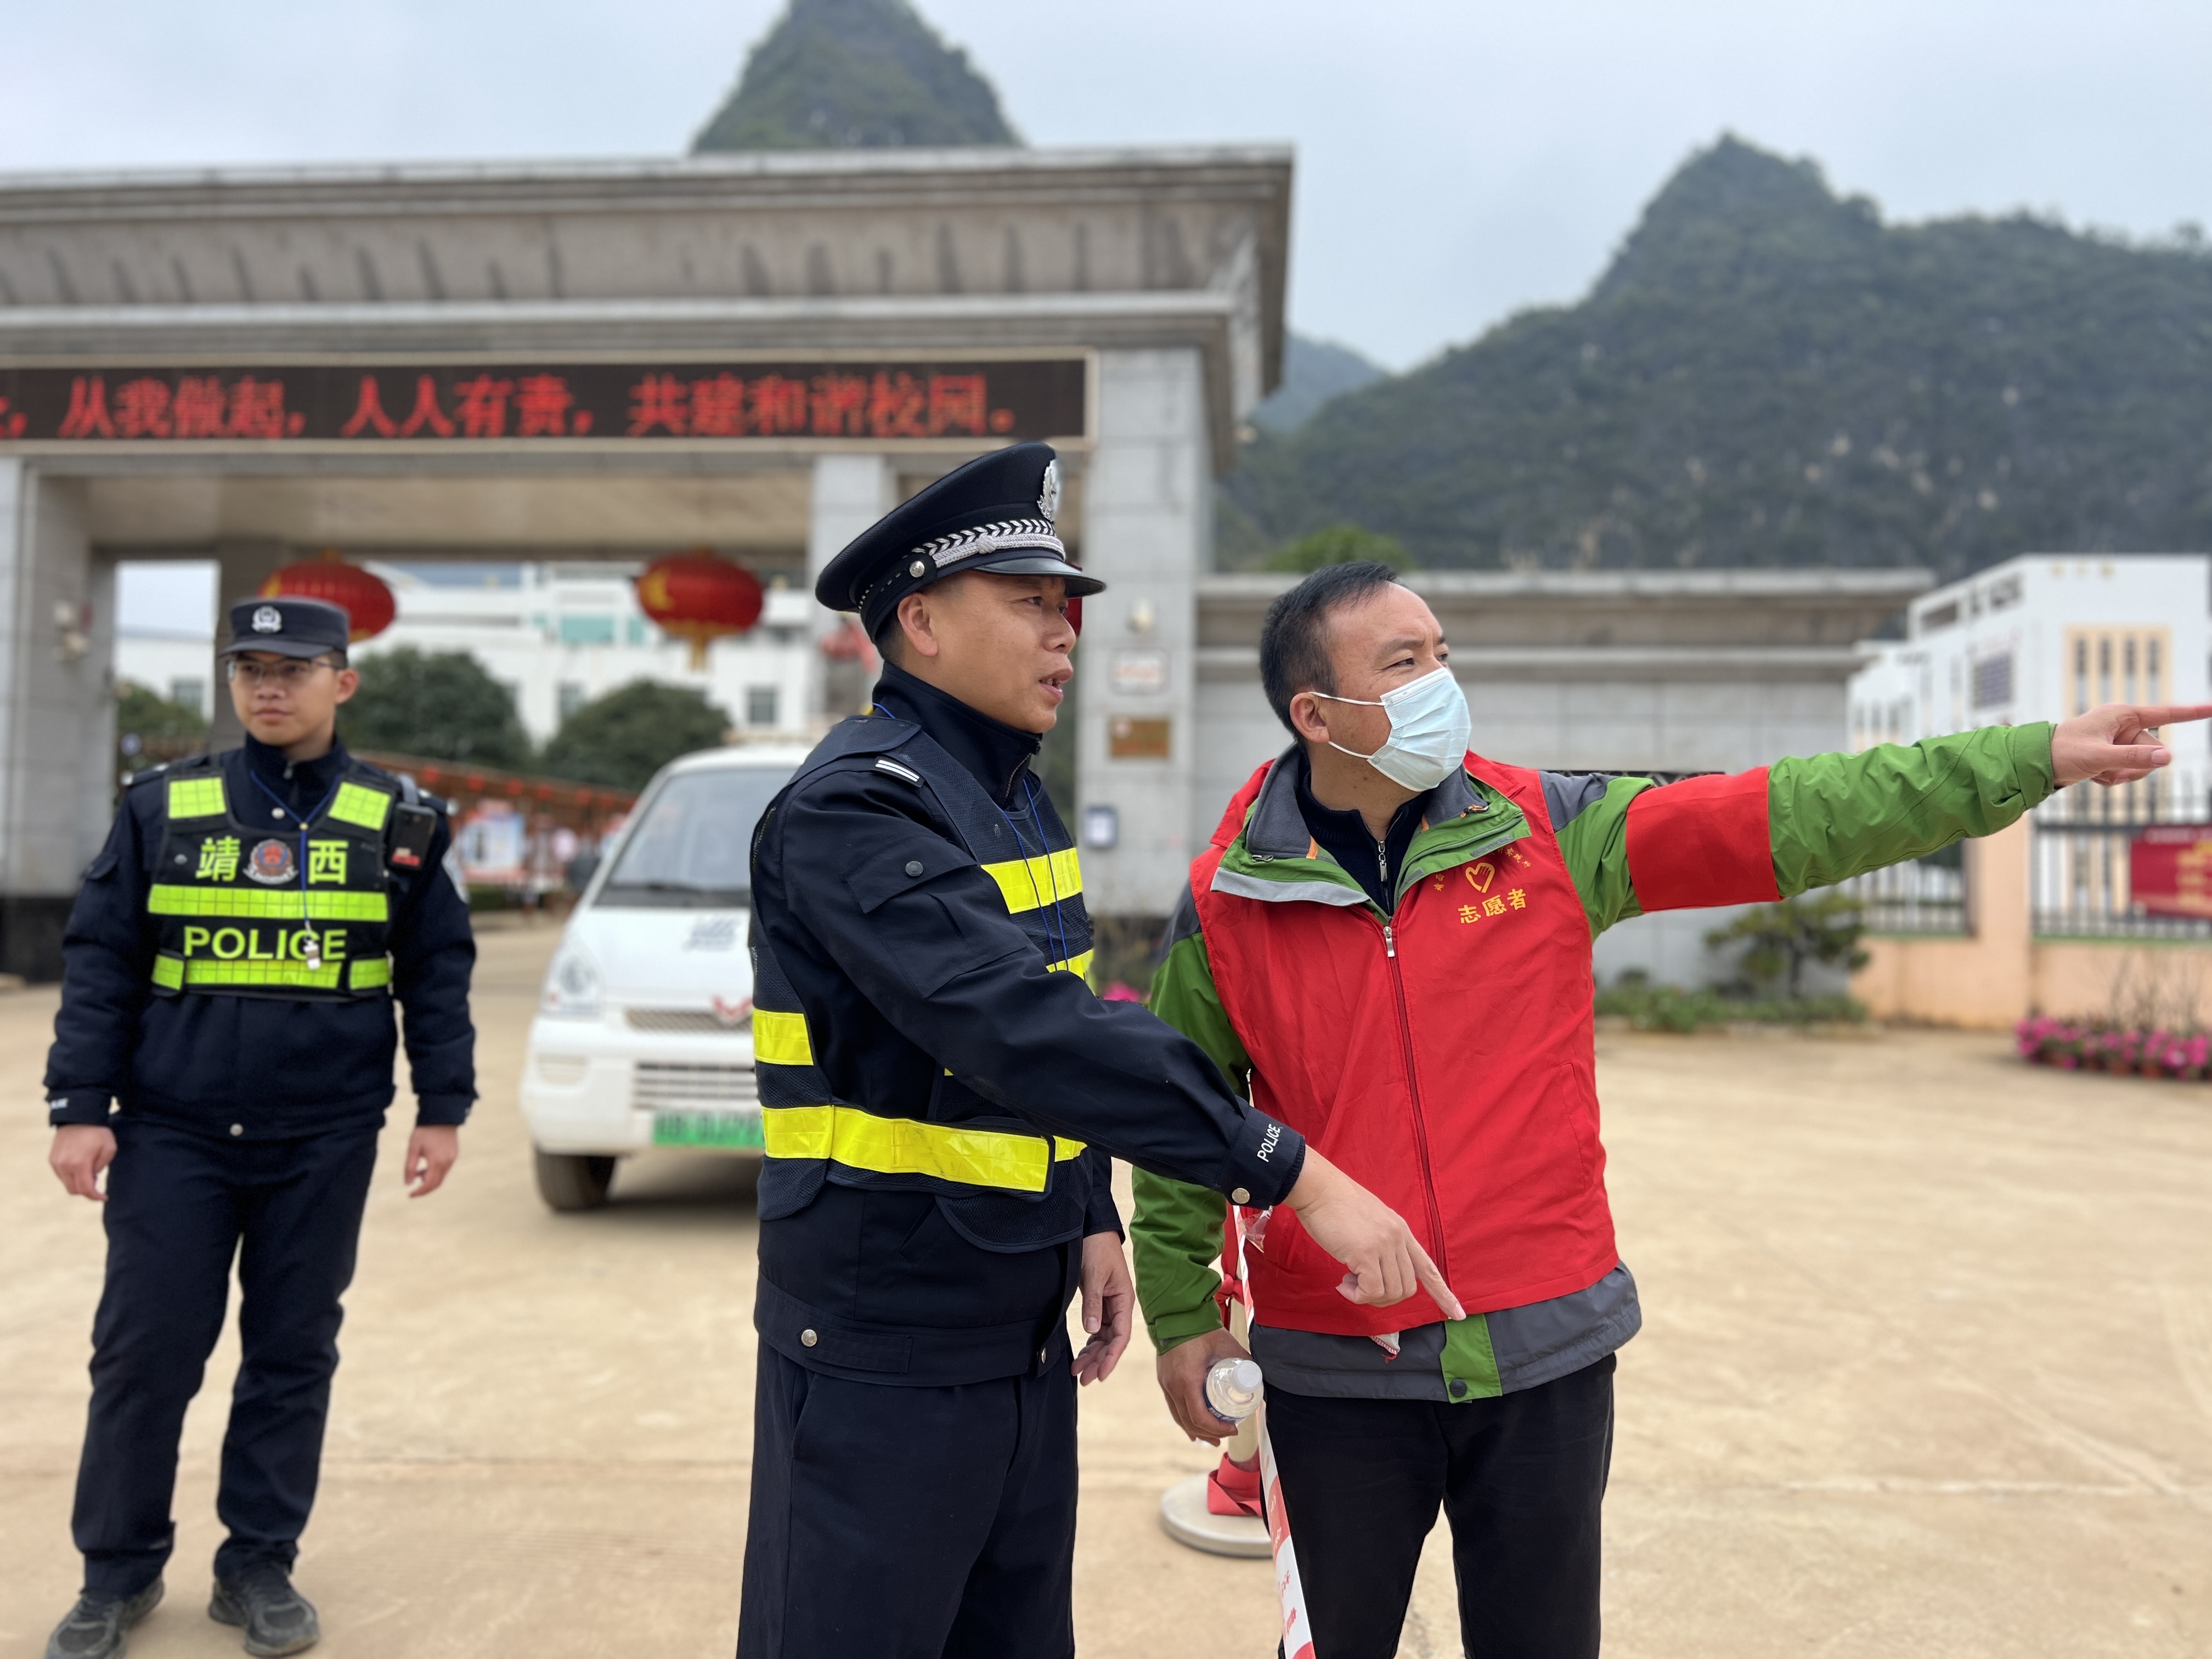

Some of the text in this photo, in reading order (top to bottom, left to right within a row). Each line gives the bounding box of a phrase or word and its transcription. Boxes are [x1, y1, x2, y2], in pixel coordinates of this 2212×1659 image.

[1458, 888, 1526, 924] 志愿者
[184, 926, 347, 960] POLICE
[1256, 1124, 1281, 1163] POLICE
